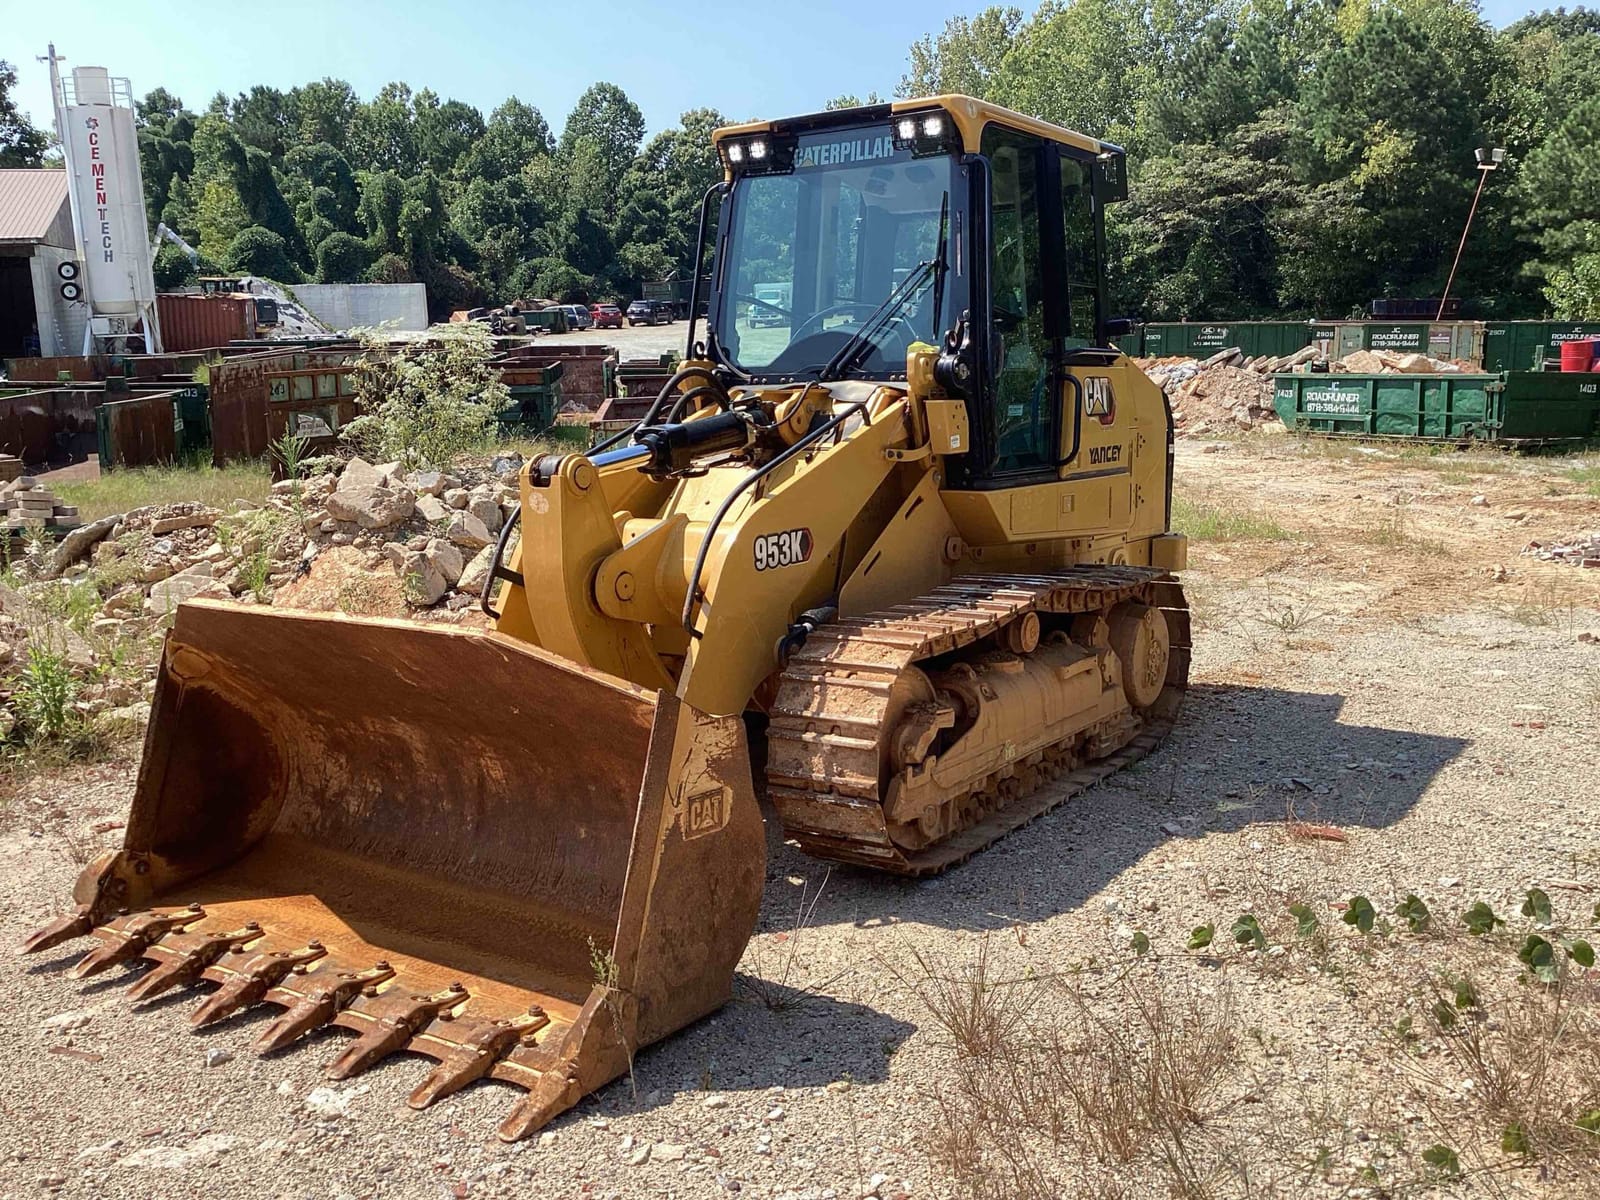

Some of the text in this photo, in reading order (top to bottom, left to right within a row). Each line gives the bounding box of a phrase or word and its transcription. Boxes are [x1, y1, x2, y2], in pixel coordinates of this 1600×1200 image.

[794, 136, 894, 168] CATERPILLAR
[1371, 333, 1420, 341] ROADRUNNER
[1083, 376, 1110, 416] CAT
[1277, 389, 1294, 398] 1403
[1306, 391, 1360, 403] ROADRUNNER
[1579, 383, 1598, 393] 1403
[1089, 444, 1122, 465] YANCEY
[754, 529, 804, 571] 953K
[690, 795, 722, 831] CAT
